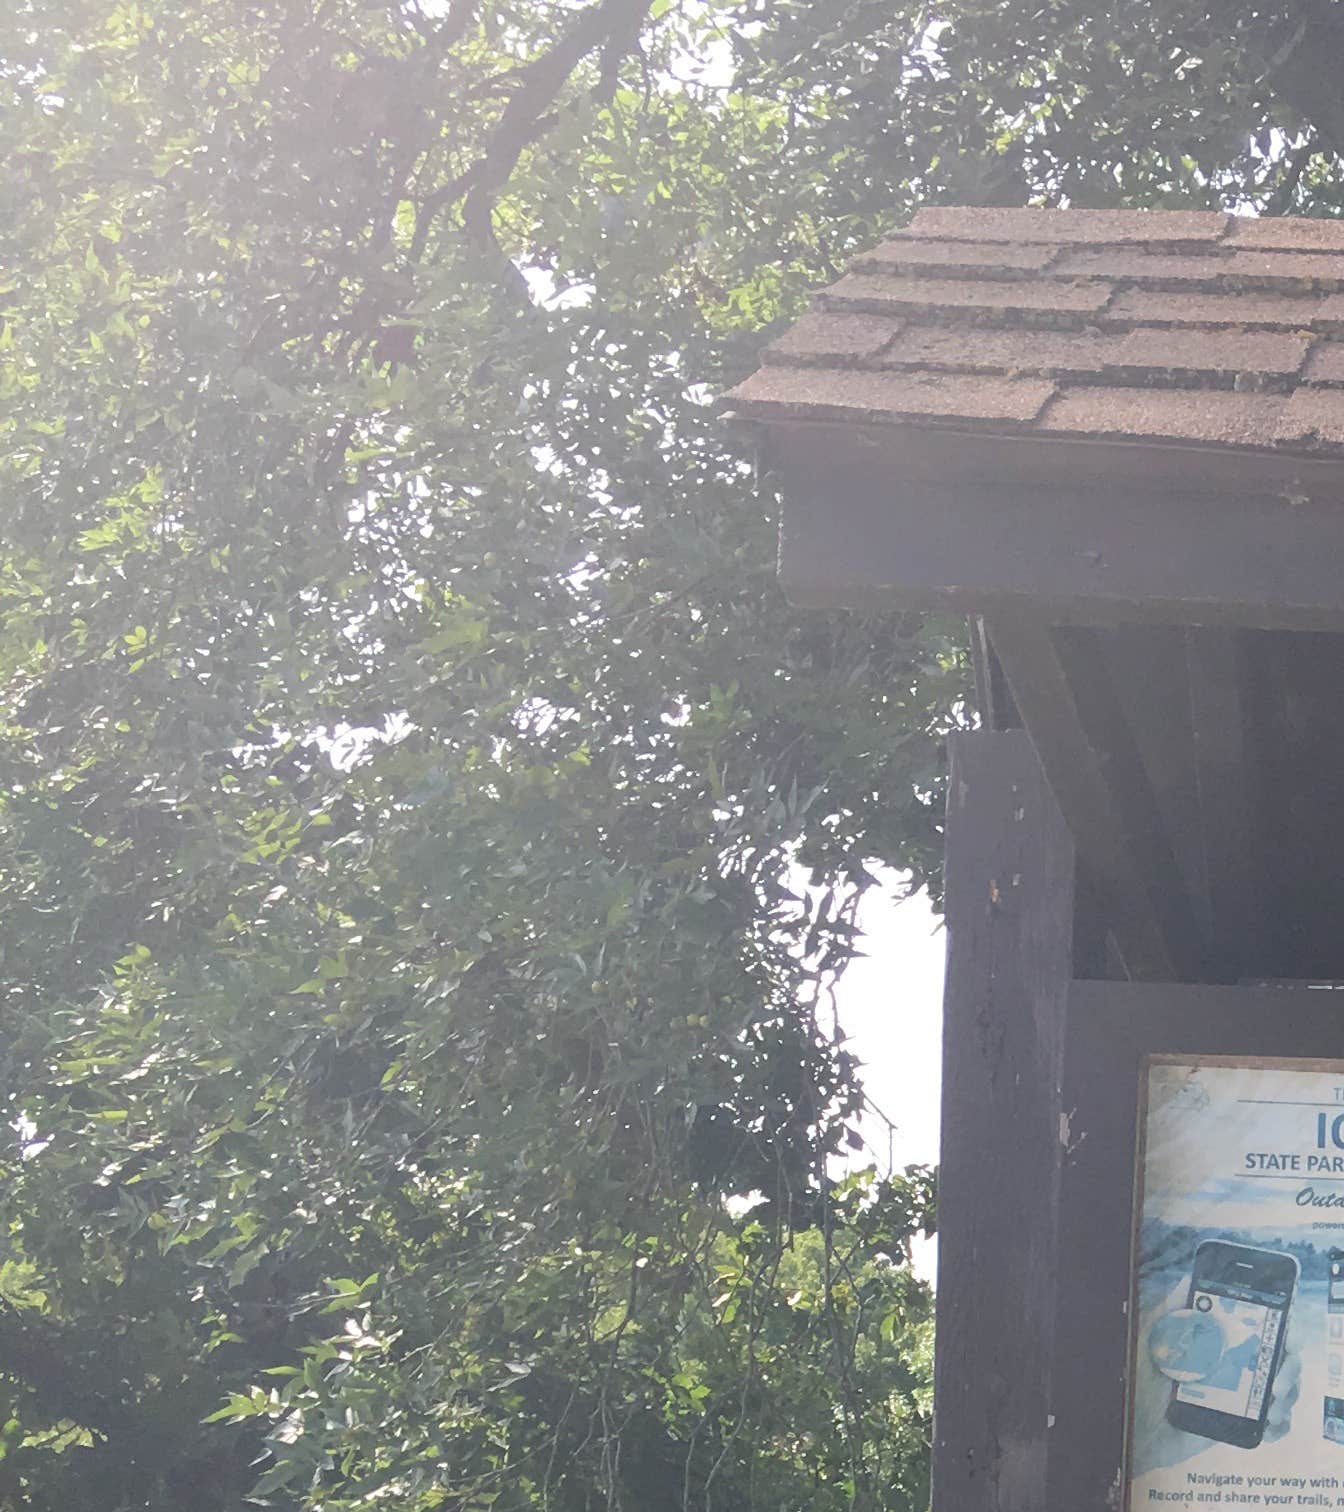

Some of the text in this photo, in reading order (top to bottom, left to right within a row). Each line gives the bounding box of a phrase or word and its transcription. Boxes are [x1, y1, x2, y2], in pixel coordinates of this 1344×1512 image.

[1245, 1152, 1301, 1170] STATE
[1187, 1473, 1243, 1487] Navigate
[1248, 1476, 1276, 1487] your
[1280, 1477, 1306, 1489] way
[1310, 1475, 1339, 1488] with
[1148, 1489, 1194, 1501] Record
[1197, 1491, 1221, 1502] and
[1225, 1492, 1260, 1504] share
[1264, 1494, 1293, 1506] your
[1297, 1493, 1333, 1507] trails,
